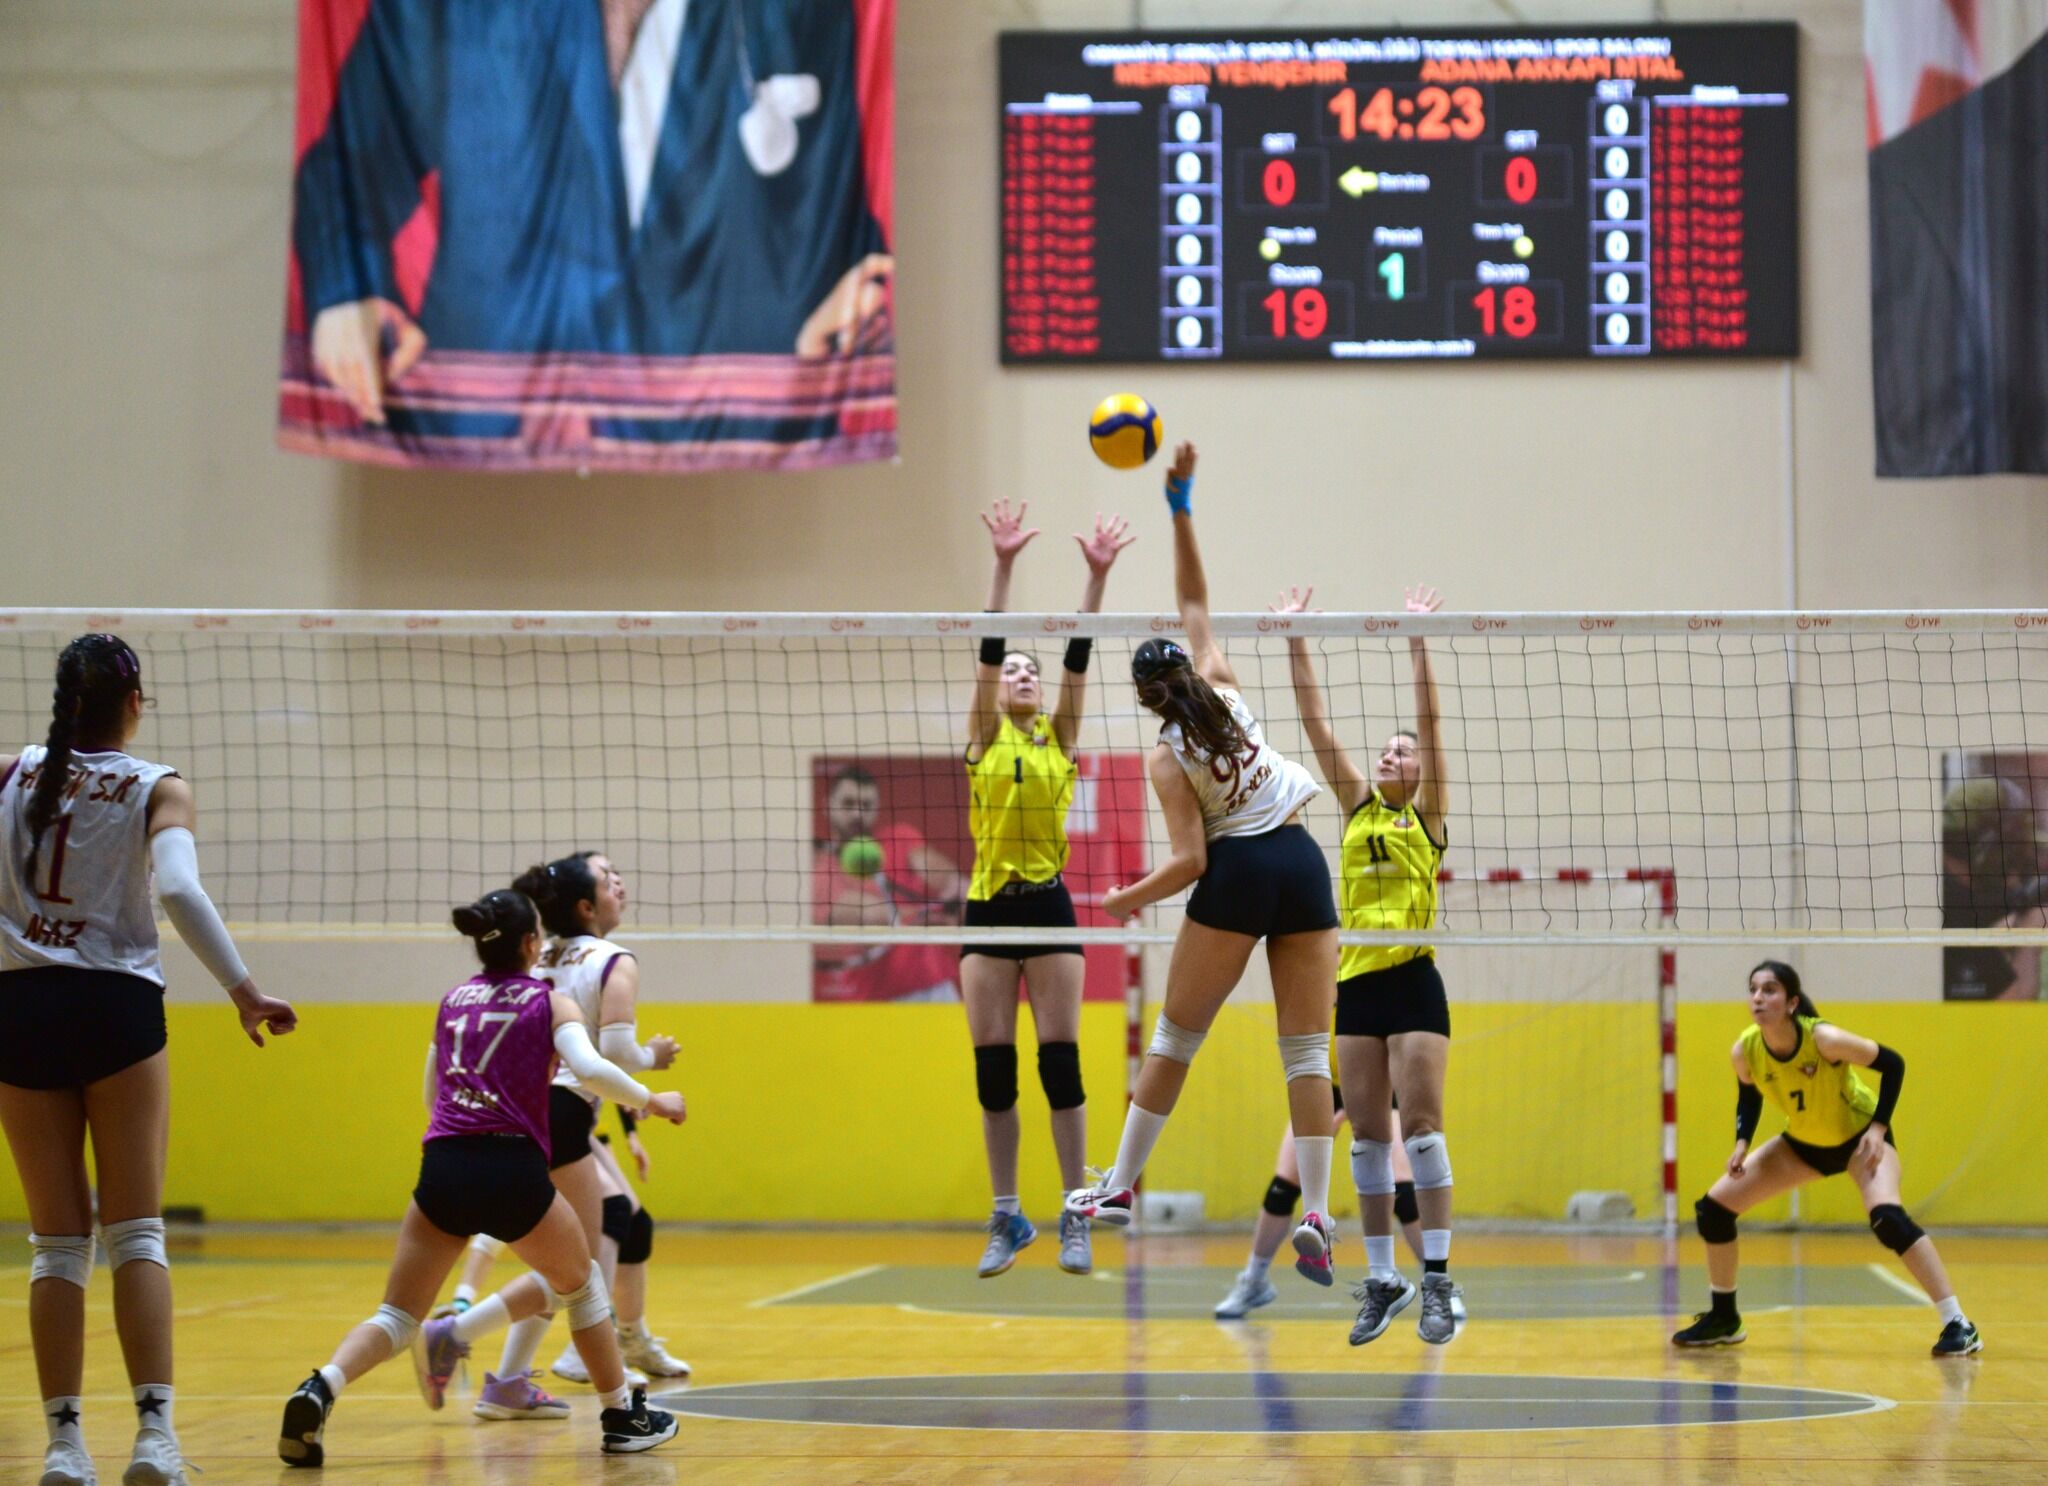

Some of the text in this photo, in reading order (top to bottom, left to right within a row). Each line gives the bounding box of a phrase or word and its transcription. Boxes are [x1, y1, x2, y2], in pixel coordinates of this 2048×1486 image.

[1419, 58, 1513, 82] ADANA
[1175, 110, 1203, 142] 0
[1327, 86, 1486, 142] 14:23
[1604, 104, 1630, 136] 0
[1175, 151, 1203, 183] 0
[1604, 146, 1630, 178] 0
[1263, 159, 1296, 207] 0
[1504, 156, 1538, 204] 0
[1175, 192, 1203, 225] 0
[1604, 188, 1630, 220] 0
[1175, 234, 1203, 266] 0
[1604, 230, 1630, 262] 0
[1175, 275, 1203, 307] 0
[1378, 252, 1405, 301] 1
[1604, 271, 1630, 304] 0
[1262, 288, 1328, 340] 19
[1472, 286, 1538, 338] 18
[1175, 315, 1203, 348] 0
[1604, 312, 1630, 345] 0
[1059, 621, 1079, 629] TVF
[1272, 620, 1292, 628] TVF
[1380, 620, 1400, 628] TVF
[1488, 620, 1508, 628] TVF
[1596, 620, 1616, 628] TVF
[1704, 619, 1724, 627] TVF
[1812, 619, 1832, 627] TVF
[1921, 618, 1941, 627] TVF
[1014, 757, 1024, 784] 1
[38, 813, 74, 904] 1
[1366, 834, 1391, 862] 11
[445, 1011, 518, 1075] 17
[1789, 1089, 1806, 1112] 7
